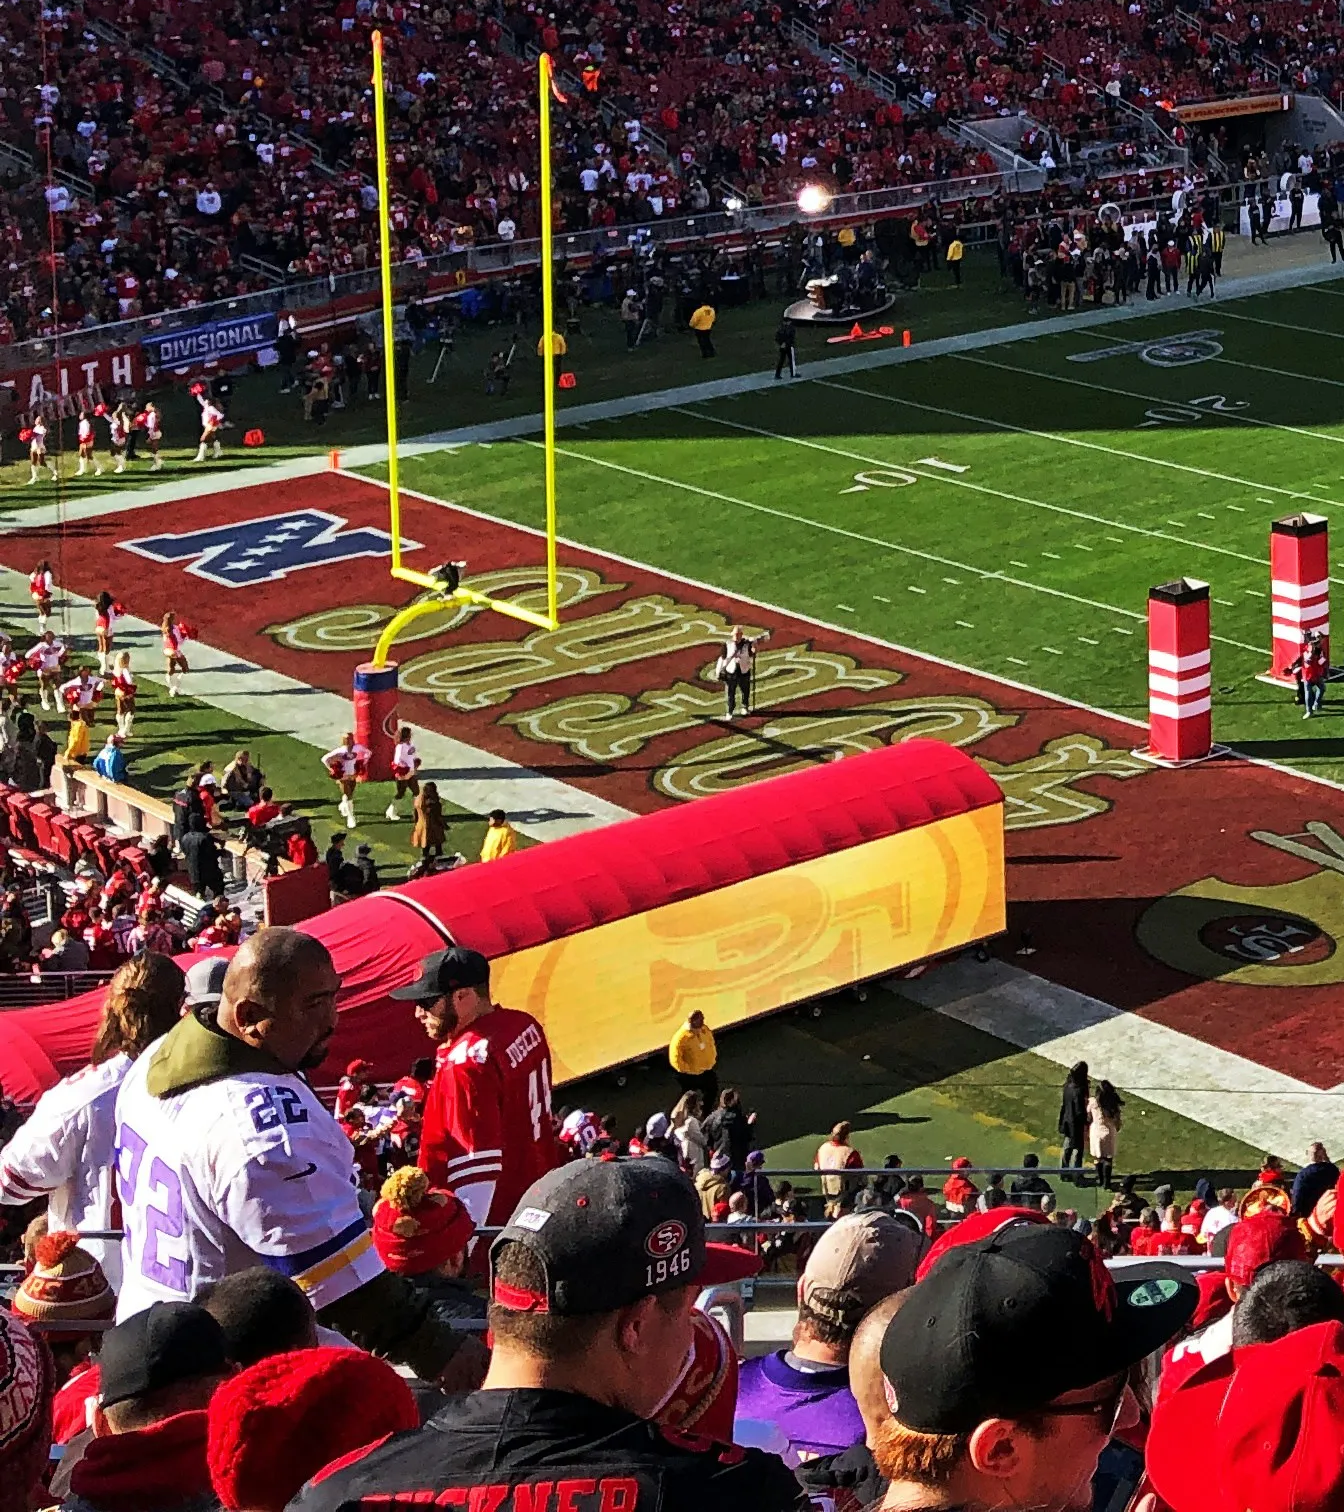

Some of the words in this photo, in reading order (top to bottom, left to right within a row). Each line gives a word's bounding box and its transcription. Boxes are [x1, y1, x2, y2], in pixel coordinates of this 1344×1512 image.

[160, 321, 265, 362] DIVISIONAL
[244, 1083, 309, 1131] 22
[644, 1251, 691, 1288] 1946
